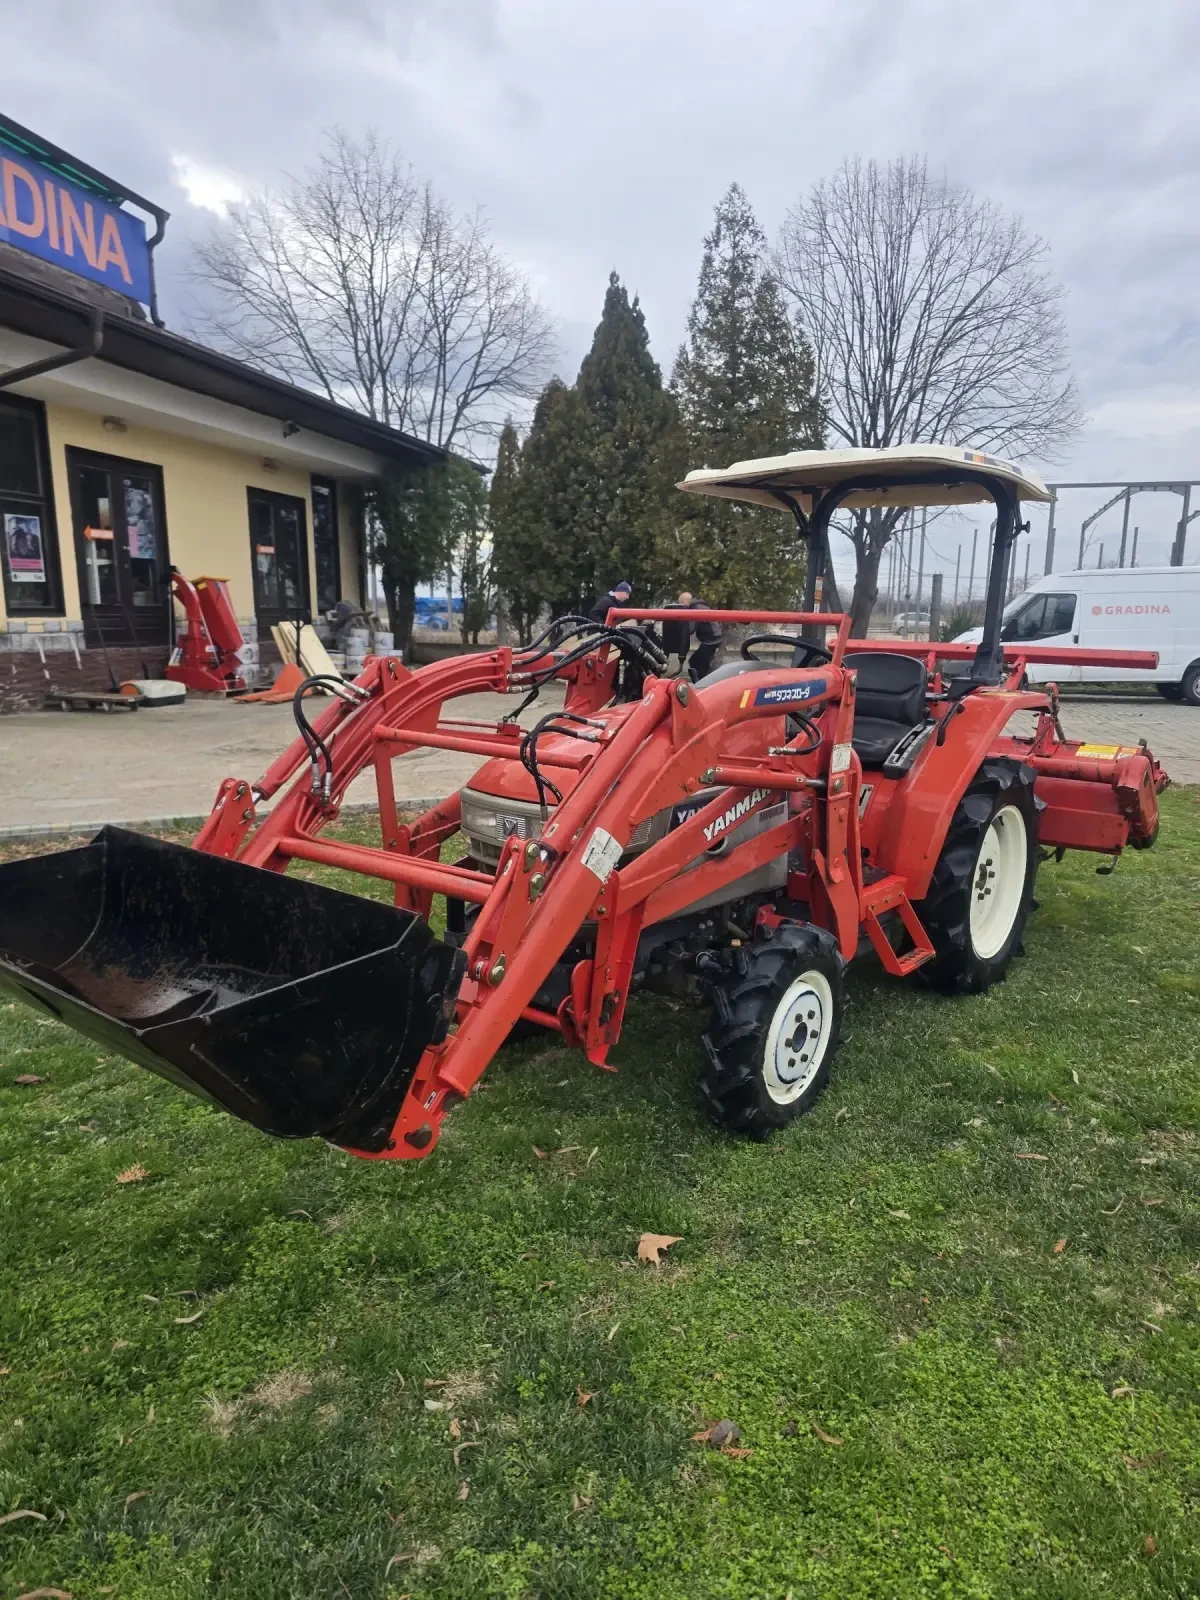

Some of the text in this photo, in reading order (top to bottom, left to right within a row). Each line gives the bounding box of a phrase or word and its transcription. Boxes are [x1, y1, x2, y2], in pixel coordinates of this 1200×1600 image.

[0, 157, 133, 285] DINA
[1105, 605, 1171, 615] GRADINA
[677, 806, 704, 824] YA
